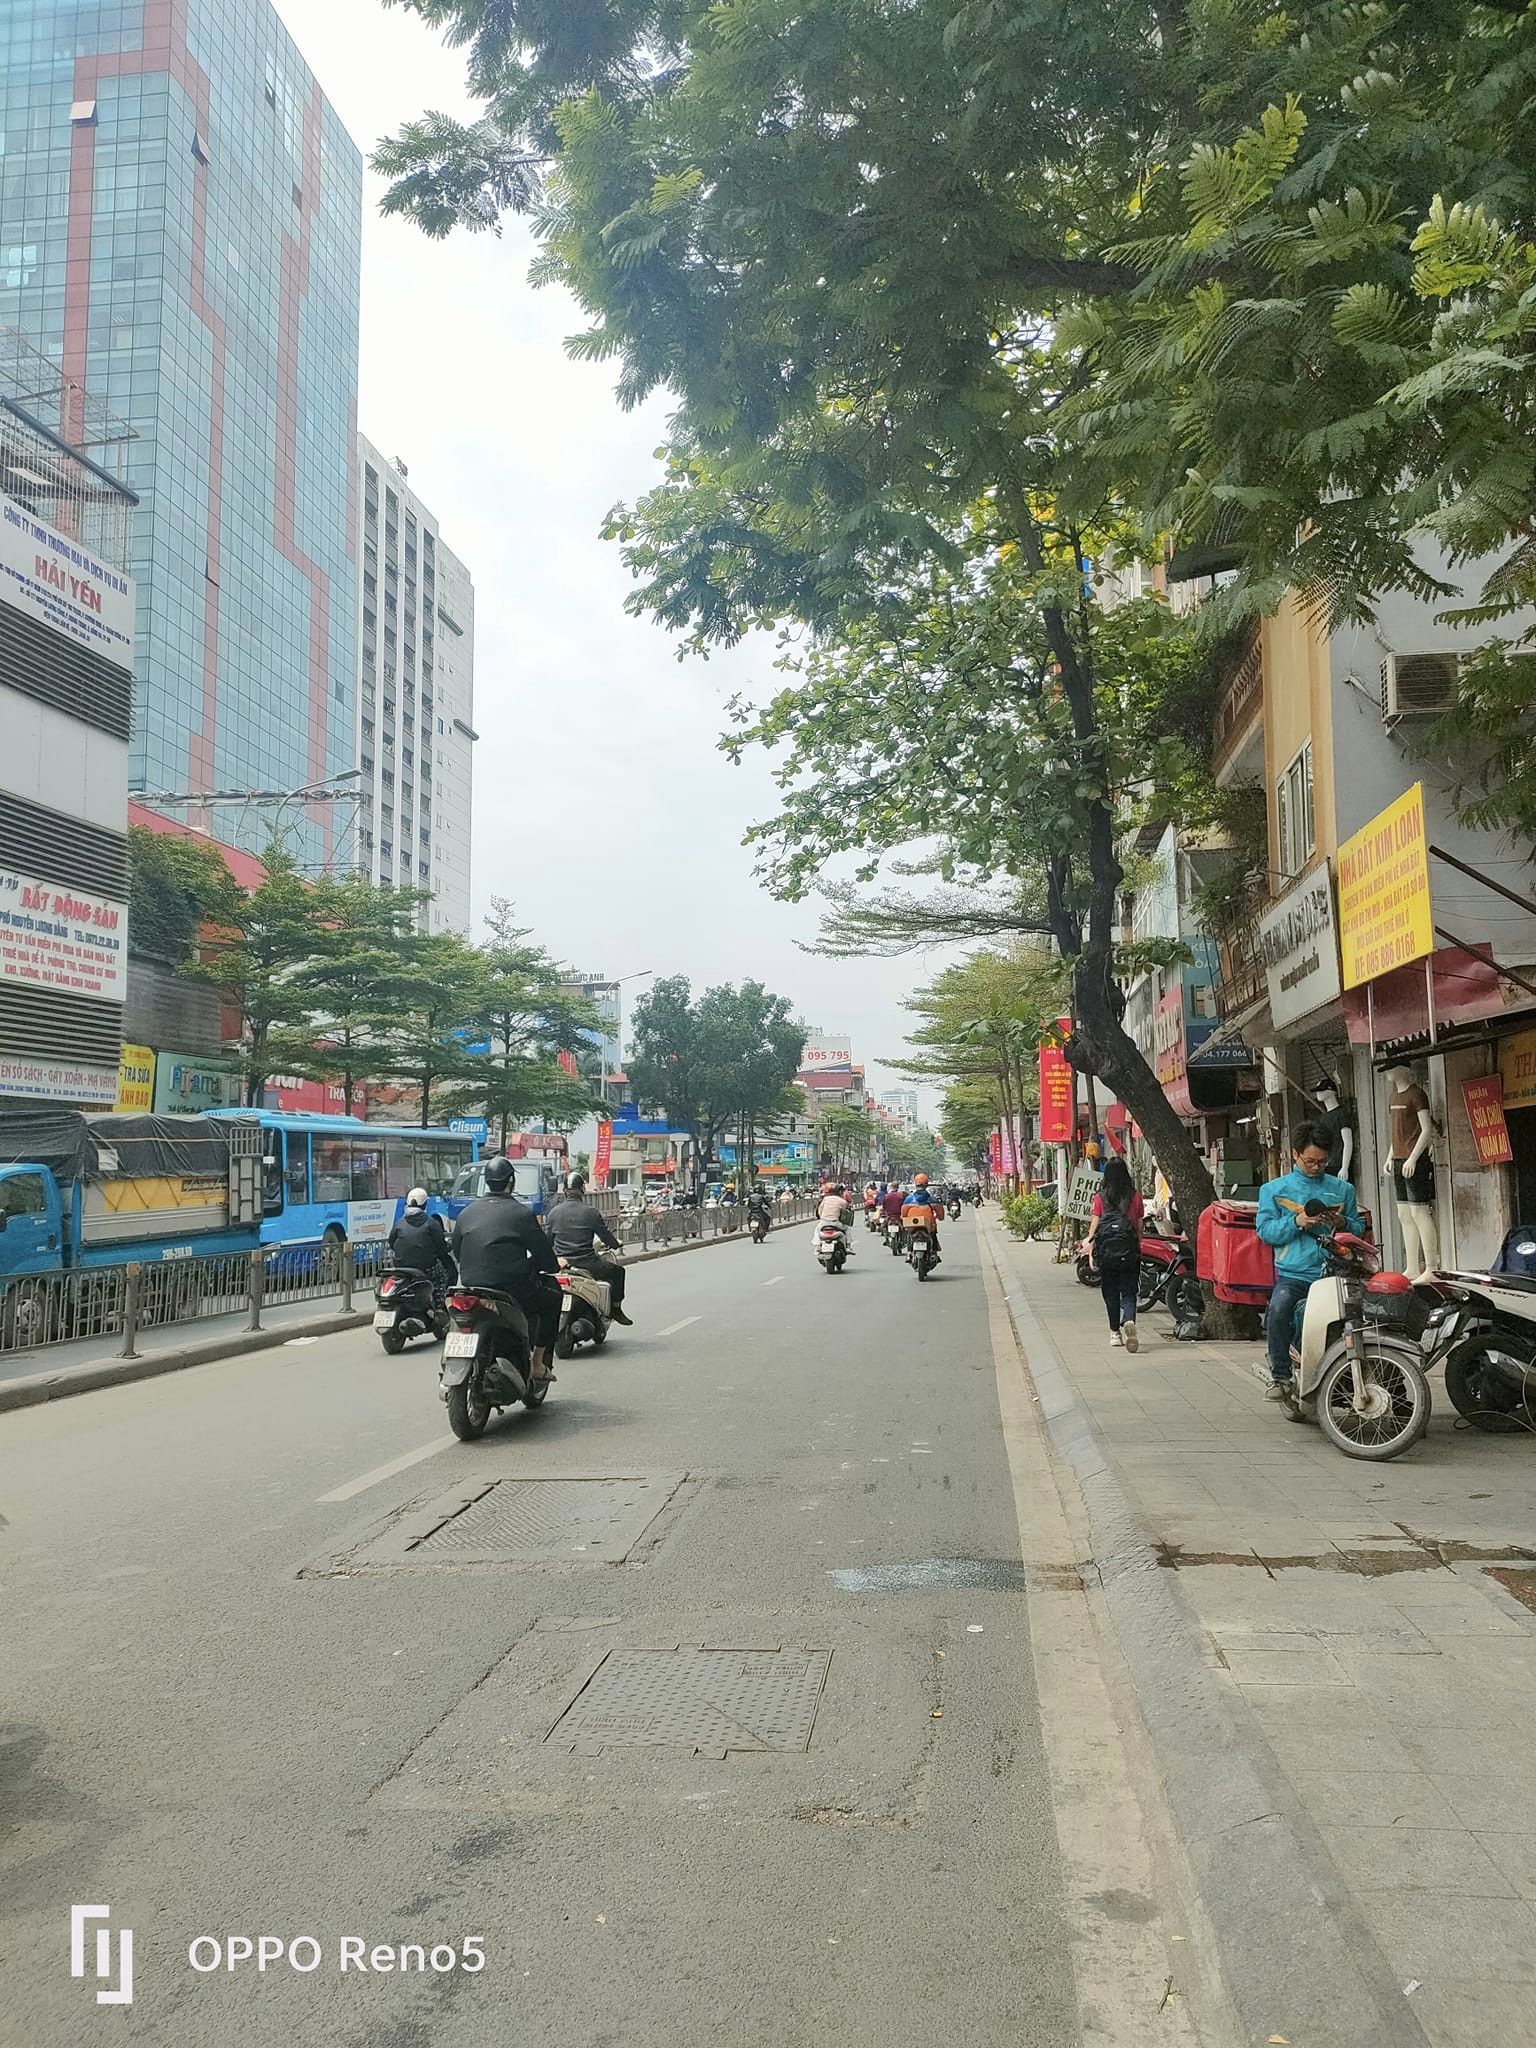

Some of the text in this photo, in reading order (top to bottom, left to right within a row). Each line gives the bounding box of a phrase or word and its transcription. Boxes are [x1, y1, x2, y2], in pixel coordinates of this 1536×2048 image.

[35, 555, 66, 592] HẢI
[70, 575, 102, 614] YẾN
[1339, 845, 1356, 892] NHÀ
[1374, 824, 1394, 868] KIM
[1394, 803, 1421, 852] LOAN
[20, 882, 119, 929] BẤT ĐỘNG SẢN
[808, 1051, 827, 1060] 095
[830, 1050, 849, 1060] 795
[449, 1120, 484, 1132] Clisun
